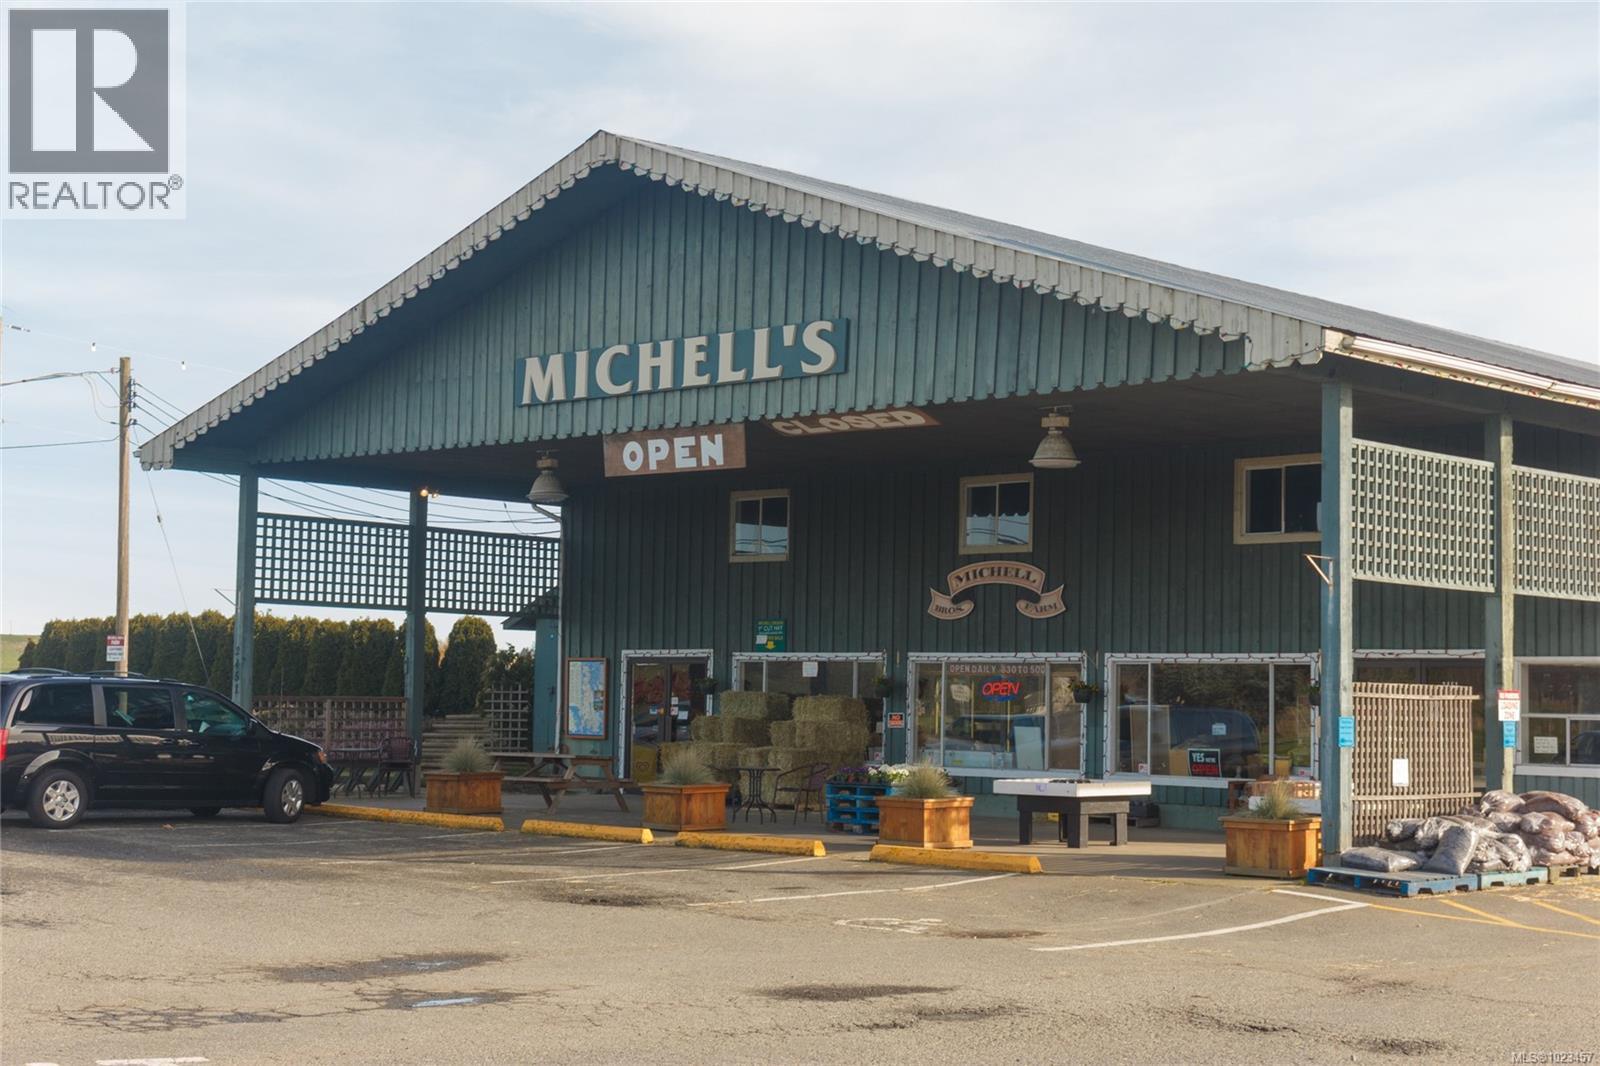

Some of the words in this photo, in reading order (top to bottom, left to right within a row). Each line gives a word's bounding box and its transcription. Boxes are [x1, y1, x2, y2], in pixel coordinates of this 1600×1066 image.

[521, 320, 838, 405] MICHELL'S
[770, 410, 927, 436] CLOSED
[622, 433, 725, 472] OPEN
[955, 566, 1037, 587] MICHELL
[1024, 602, 1058, 614] FARM
[949, 664, 970, 673] OPEN
[971, 664, 997, 673] DAILY
[1018, 665, 1029, 674] TO
[982, 682, 1019, 695] OPEN
[1191, 753, 1205, 762] YES
